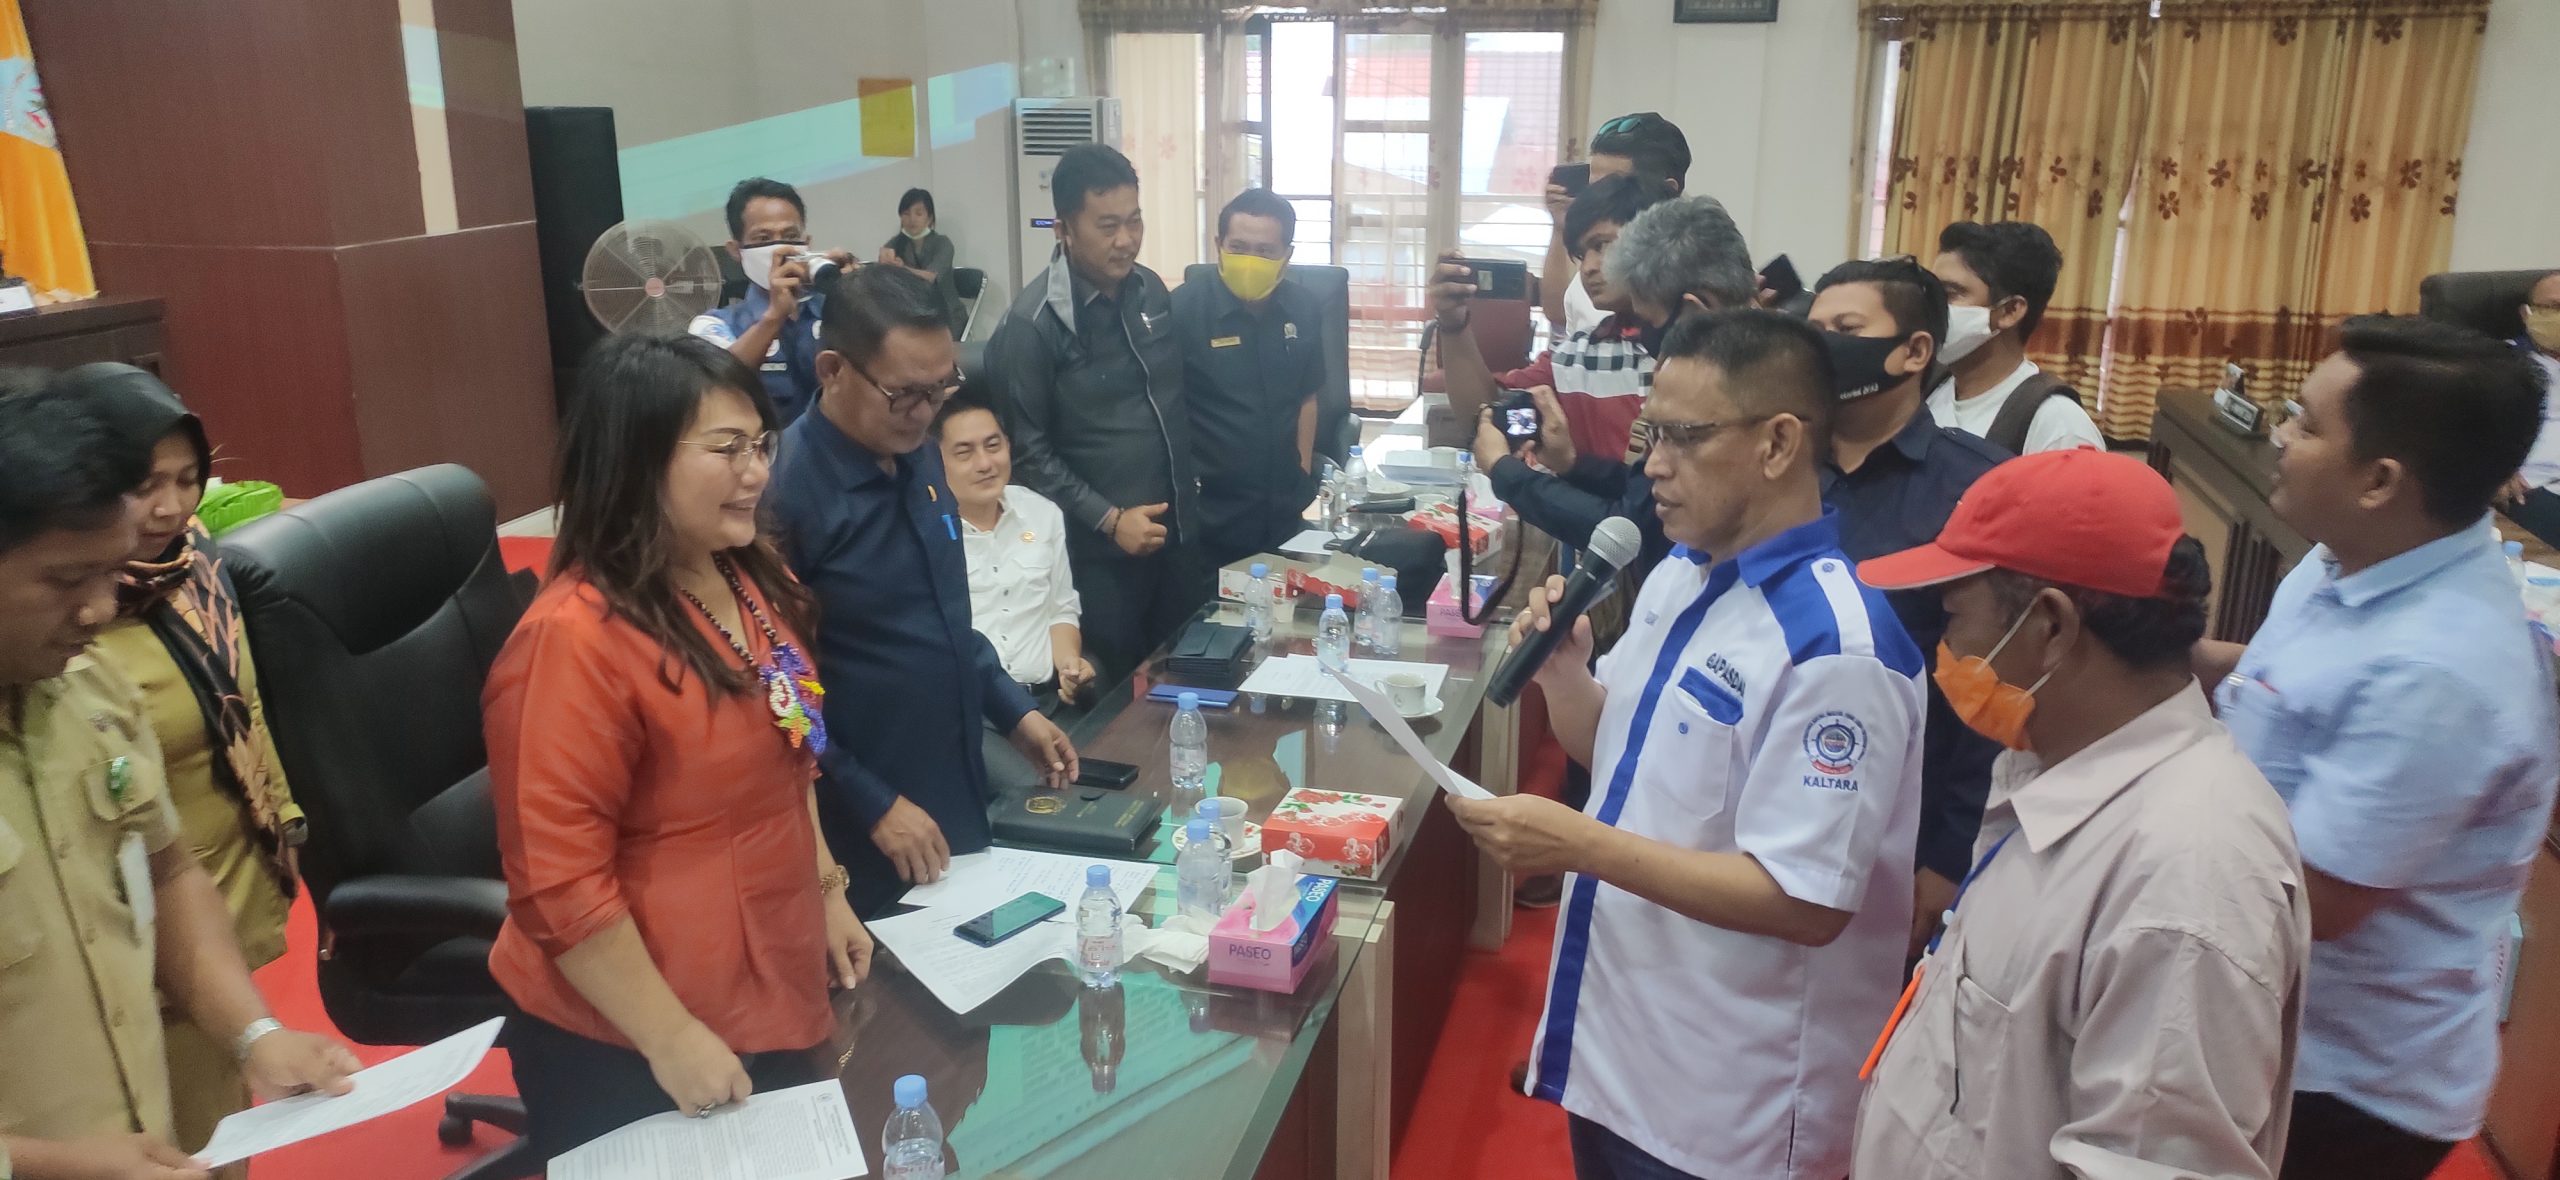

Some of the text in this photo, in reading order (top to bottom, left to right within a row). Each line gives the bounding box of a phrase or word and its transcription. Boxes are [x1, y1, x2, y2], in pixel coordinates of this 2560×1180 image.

[1803, 775, 1858, 791] KALTARA
[1305, 879, 1332, 901] PASEO
[1229, 944, 1271, 960] PASEO
